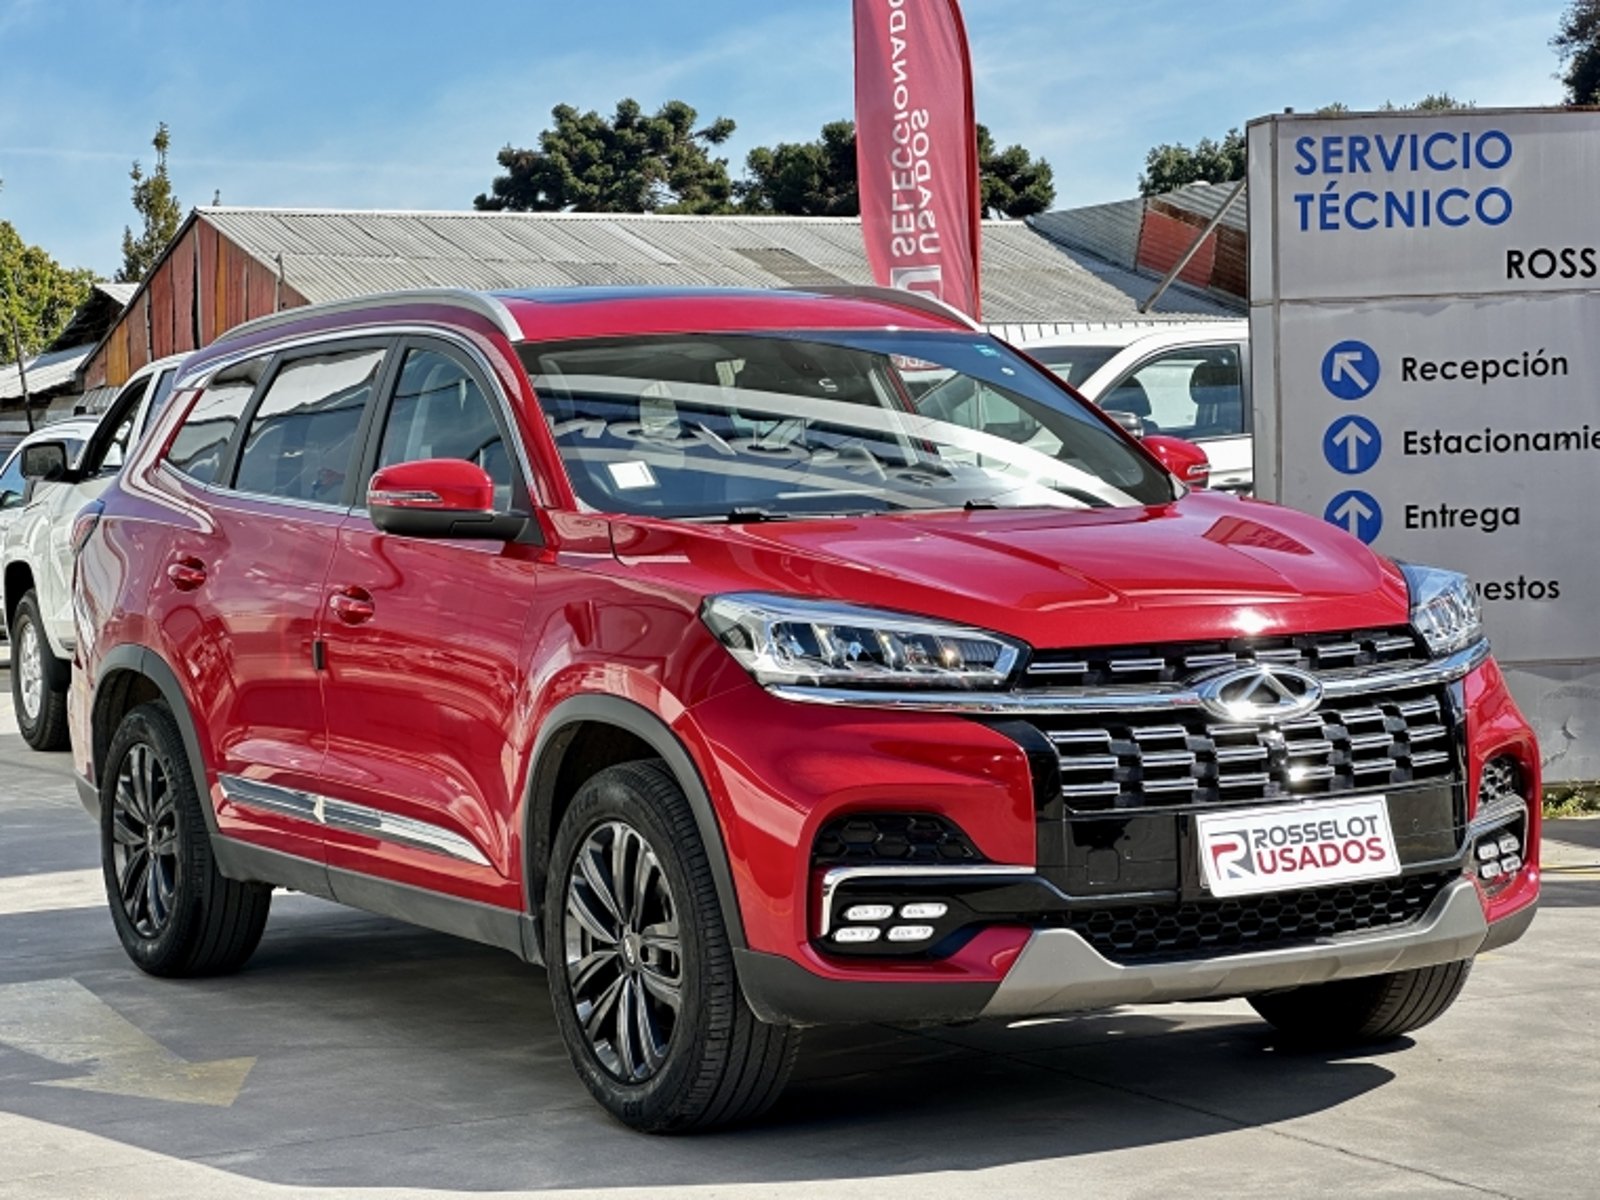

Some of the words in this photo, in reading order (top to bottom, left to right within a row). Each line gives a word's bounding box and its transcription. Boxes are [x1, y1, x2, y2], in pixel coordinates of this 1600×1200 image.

[1295, 130, 1513, 176] SERVICIO
[1294, 181, 1513, 231] TÉCNICO
[1507, 248, 1597, 279] ROSS
[1402, 349, 1568, 384] Recepción
[1405, 504, 1520, 533] Entrega
[1475, 575, 1560, 600] estos
[1252, 815, 1378, 848] ROSSELOT
[1257, 837, 1386, 874] USADOS
